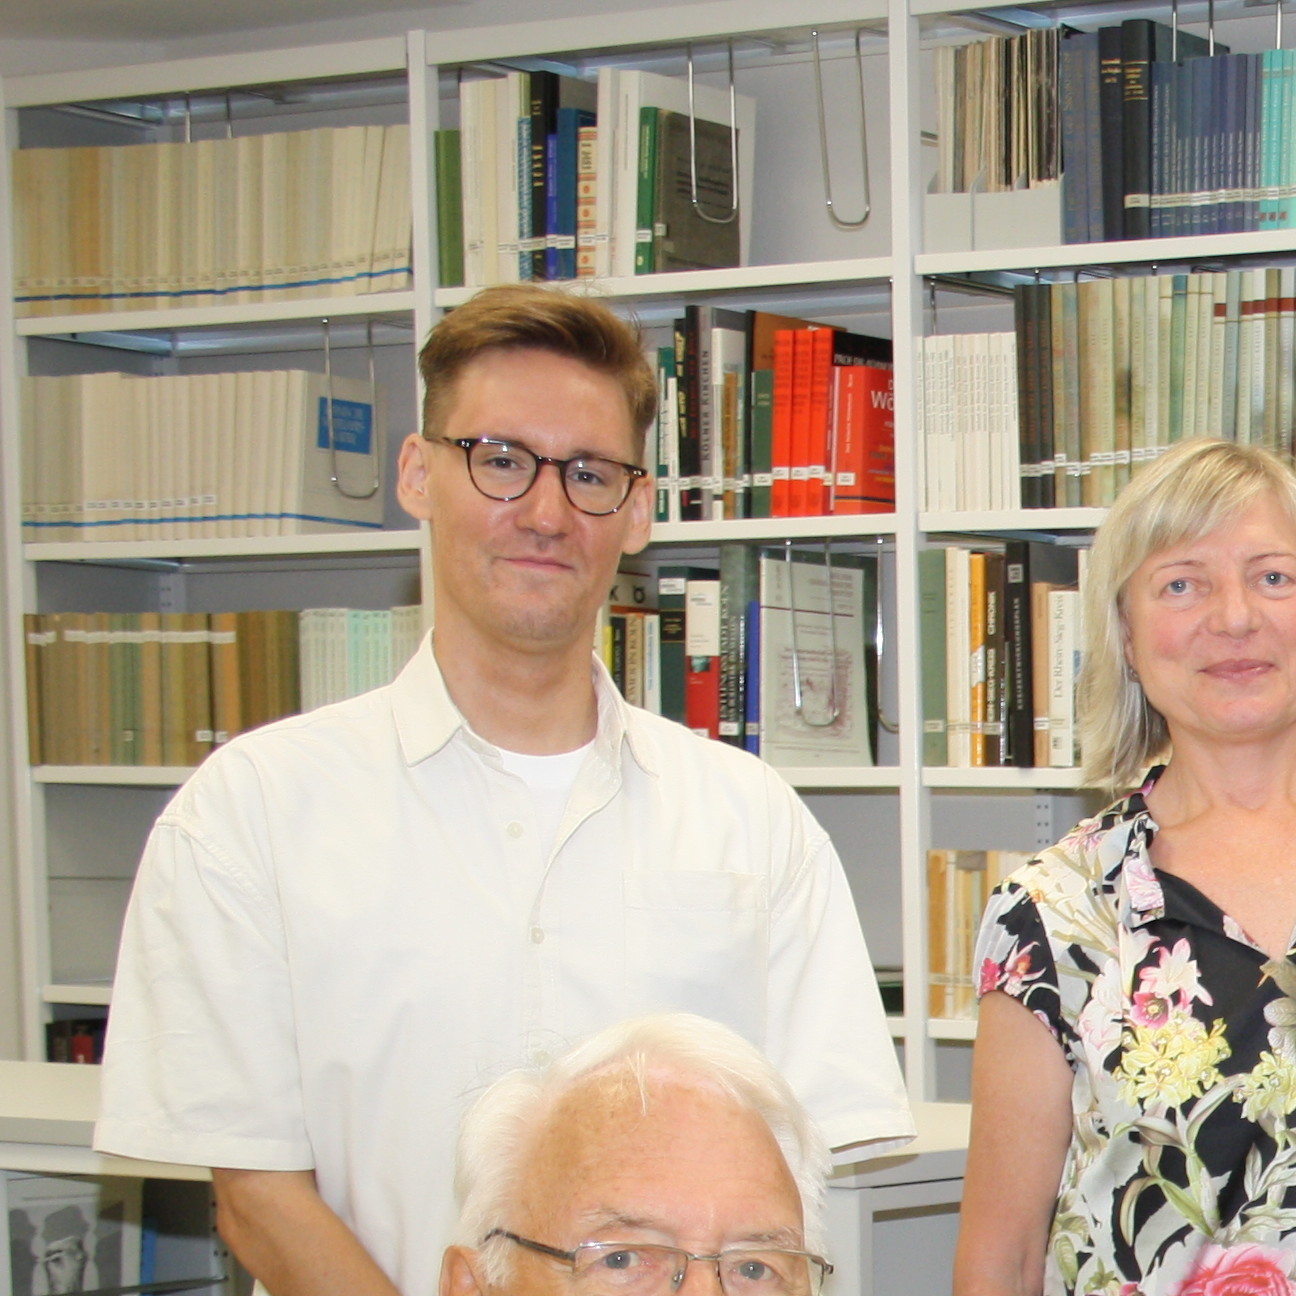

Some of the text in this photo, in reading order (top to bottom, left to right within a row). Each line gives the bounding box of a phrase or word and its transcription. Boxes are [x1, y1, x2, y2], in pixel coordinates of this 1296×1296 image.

[701, 350, 710, 461] KÖLNER KIRCHEN
[986, 591, 996, 636] CHRONIK
[1053, 681, 1063, 698] Der
